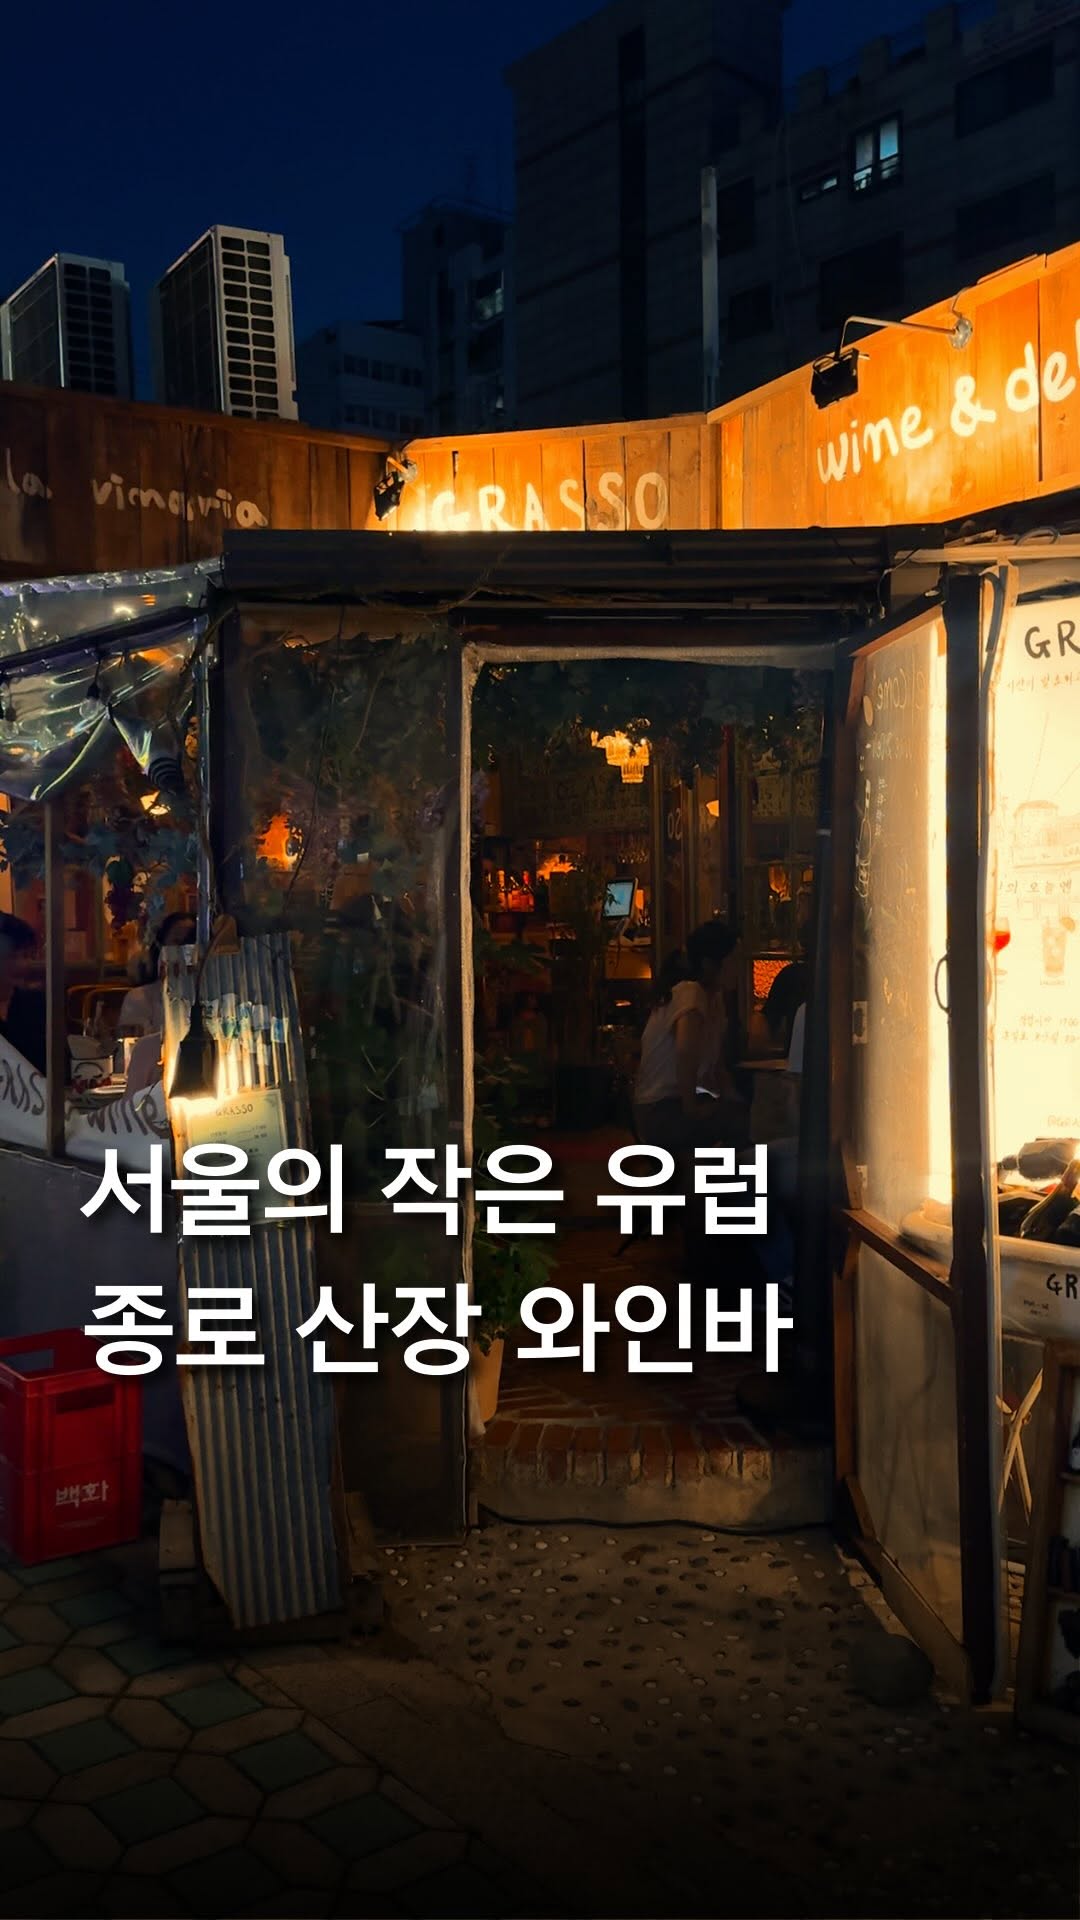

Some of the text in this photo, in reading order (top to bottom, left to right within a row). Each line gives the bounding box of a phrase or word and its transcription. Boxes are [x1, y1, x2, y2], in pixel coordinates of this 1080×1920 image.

[817, 405, 934, 484] wine
[950, 375, 996, 437] &
[431, 471, 668, 531] GRASSO
[55, 1479, 109, 1509] 백화
